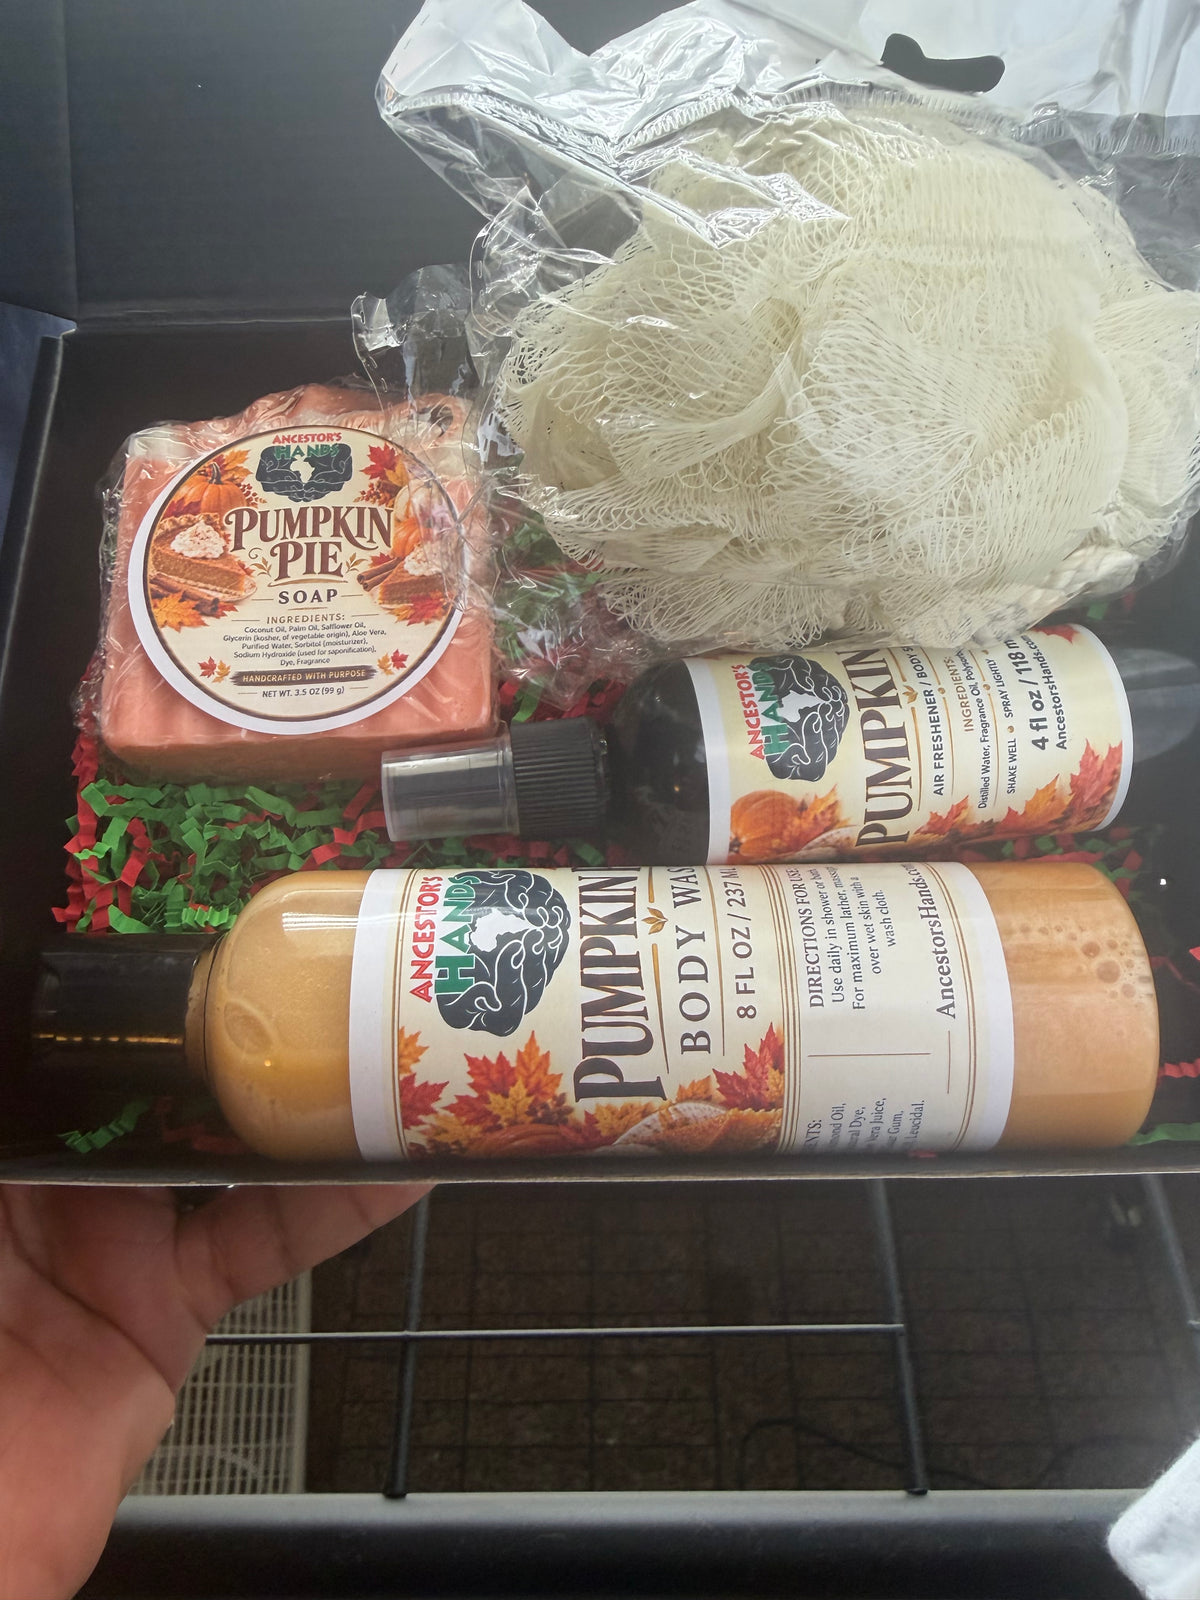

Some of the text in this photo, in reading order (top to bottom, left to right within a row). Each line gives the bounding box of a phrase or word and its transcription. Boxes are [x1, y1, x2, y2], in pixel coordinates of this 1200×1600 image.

[272, 433, 341, 444] ANCESTOR'S
[274, 444, 340, 460] HANDS
[224, 506, 394, 552] PUMPKIN
[270, 541, 344, 581] PIE
[278, 588, 338, 604] SOAP
[267, 614, 345, 624] INGREDIENTS:
[275, 625, 287, 633] Oil,
[308, 624, 319, 632] Oil,
[321, 622, 352, 630] Safflower
[354, 621, 366, 629] Oil,
[223, 634, 252, 642] Glycerin
[254, 633, 281, 642] (kosher,
[290, 632, 324, 641] vegetable
[326, 631, 350, 639] origin),
[352, 628, 368, 637] Aloe
[369, 628, 387, 636] Vera,
[271, 642, 293, 650] Water,
[294, 640, 322, 648] Sorbitol
[323, 638, 368, 648] (moisturizer),
[261, 650, 296, 659] Hydroxide
[297, 649, 316, 658] (used
[328, 646, 376, 656] saponification),
[297, 657, 330, 666] Fragrance
[1008, 651, 1032, 675] 118
[242, 674, 302, 682] HANDCRAFTED
[328, 670, 366, 679] PURPOSE
[909, 653, 927, 679] BODY
[262, 686, 345, 698] NET WT. 3.5 OZ (99 g)
[944, 656, 973, 732] INGREDIENTS:
[970, 681, 980, 696] Oil,
[986, 658, 1013, 718] SPRAY LIGHTLY
[731, 664, 765, 760] ANCESTOR'S
[749, 662, 790, 756] HANDS
[1028, 690, 1044, 712] oz
[923, 689, 944, 769] FRESHENER
[976, 698, 990, 742] Fragrance
[1029, 717, 1048, 732] fl
[836, 650, 913, 847] PUMPKIN
[1031, 736, 1049, 750] 4
[980, 744, 990, 777] Water,
[1007, 738, 1017, 794] SHAKE WELL
[933, 774, 944, 796] AIR
[978, 779, 990, 809] Distilled
[723, 881, 746, 907] 237
[792, 883, 810, 906] FOR
[815, 881, 825, 889] or
[850, 881, 865, 899] with
[820, 890, 834, 925] shower
[836, 890, 852, 919] lather,
[858, 900, 872, 920] skin
[872, 890, 896, 946] wash cloth.
[409, 876, 443, 1002] ANCESTOR'S
[435, 874, 481, 995] HANDS
[731, 926, 753, 960] OZ
[825, 929, 837, 940] in
[864, 923, 877, 944] wet
[798, 908, 824, 1008] DIRECTIONS
[826, 944, 842, 974] daily
[847, 922, 862, 983] maximum
[869, 946, 881, 974] over
[572, 874, 668, 1102] PUMPKIN
[676, 924, 711, 1055] BODY
[735, 966, 755, 995] FL
[831, 978, 845, 1003] Use
[852, 987, 865, 1010] For
[736, 1004, 757, 1019] 8
[831, 1103, 846, 1121] Oil,
[849, 1106, 866, 1128] Dye,
[870, 1098, 886, 1124] Juice,
